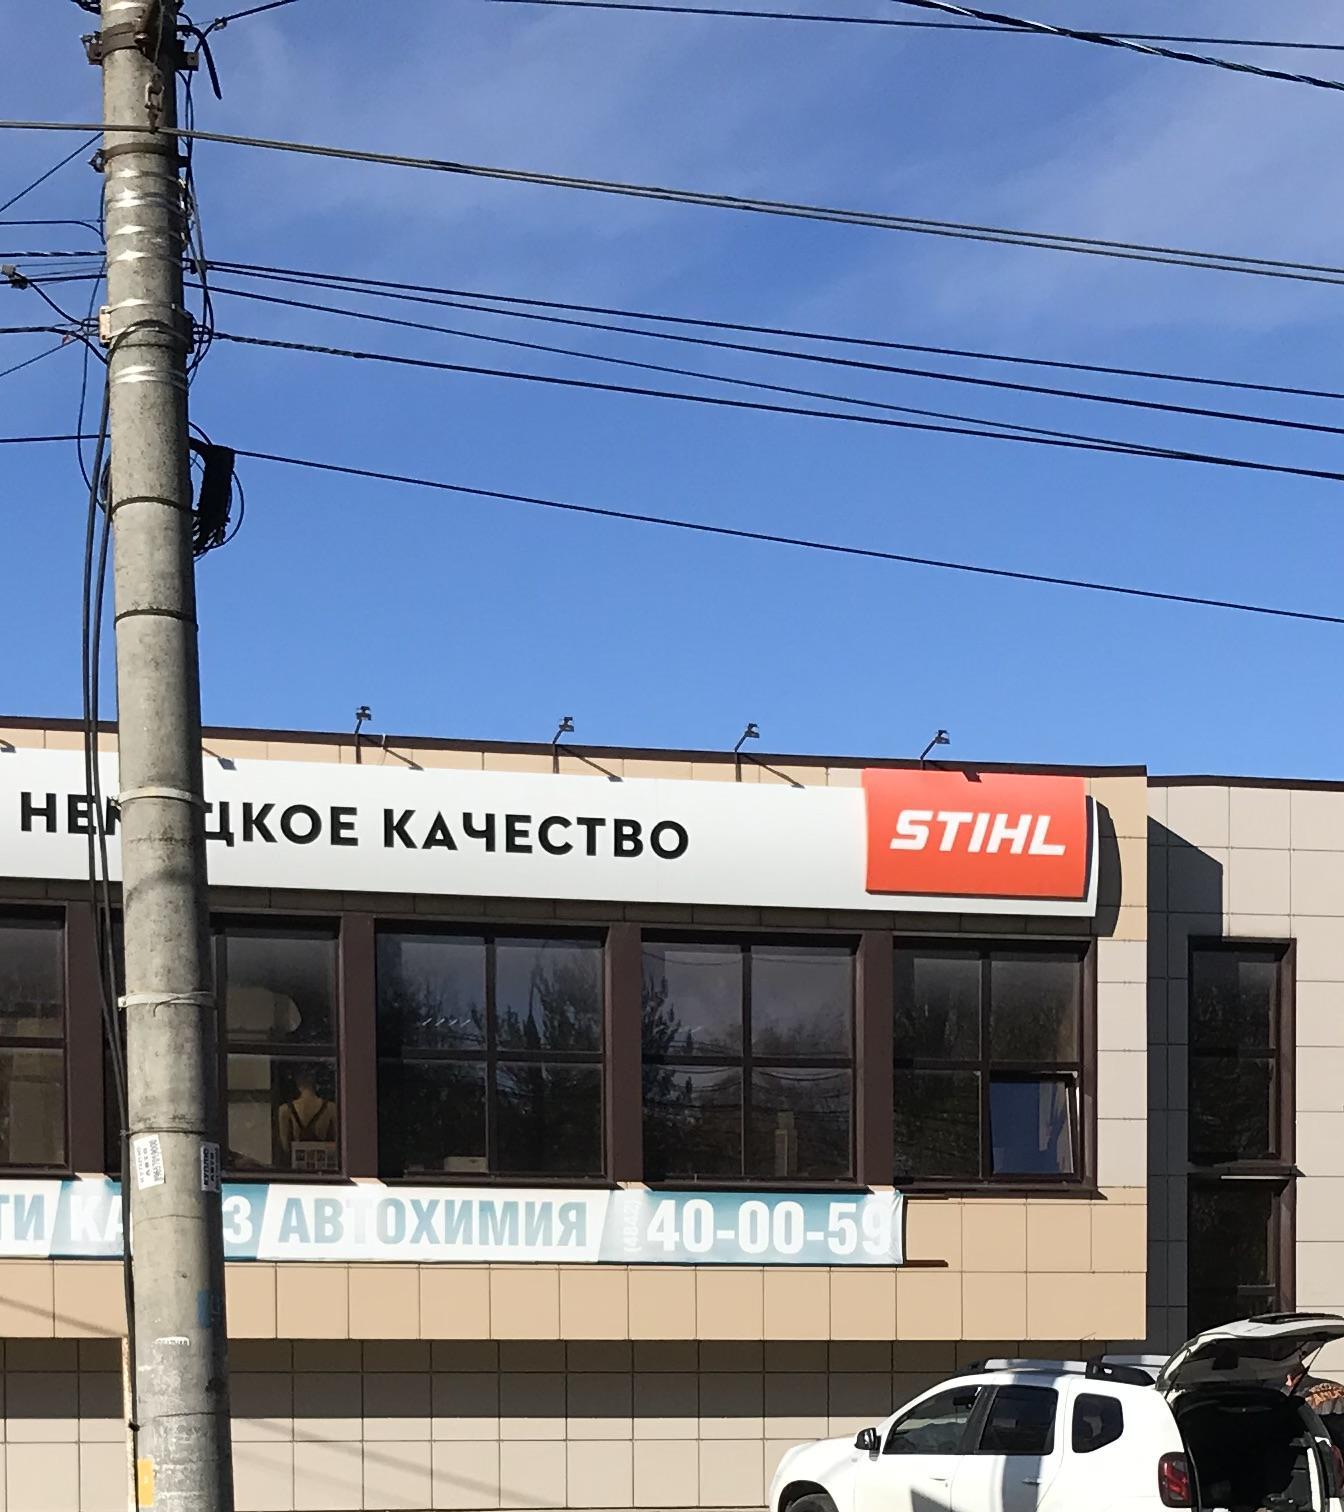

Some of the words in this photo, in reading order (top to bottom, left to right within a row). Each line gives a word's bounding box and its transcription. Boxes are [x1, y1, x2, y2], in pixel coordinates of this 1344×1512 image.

[20, 791, 358, 848] НЕЦКОЕ
[384, 807, 689, 860] КАЧЕСТВО
[889, 809, 1067, 856] STIHL
[277, 1196, 587, 1248] АВТОХИМИЯ
[646, 1198, 893, 1256] 40-00-59
